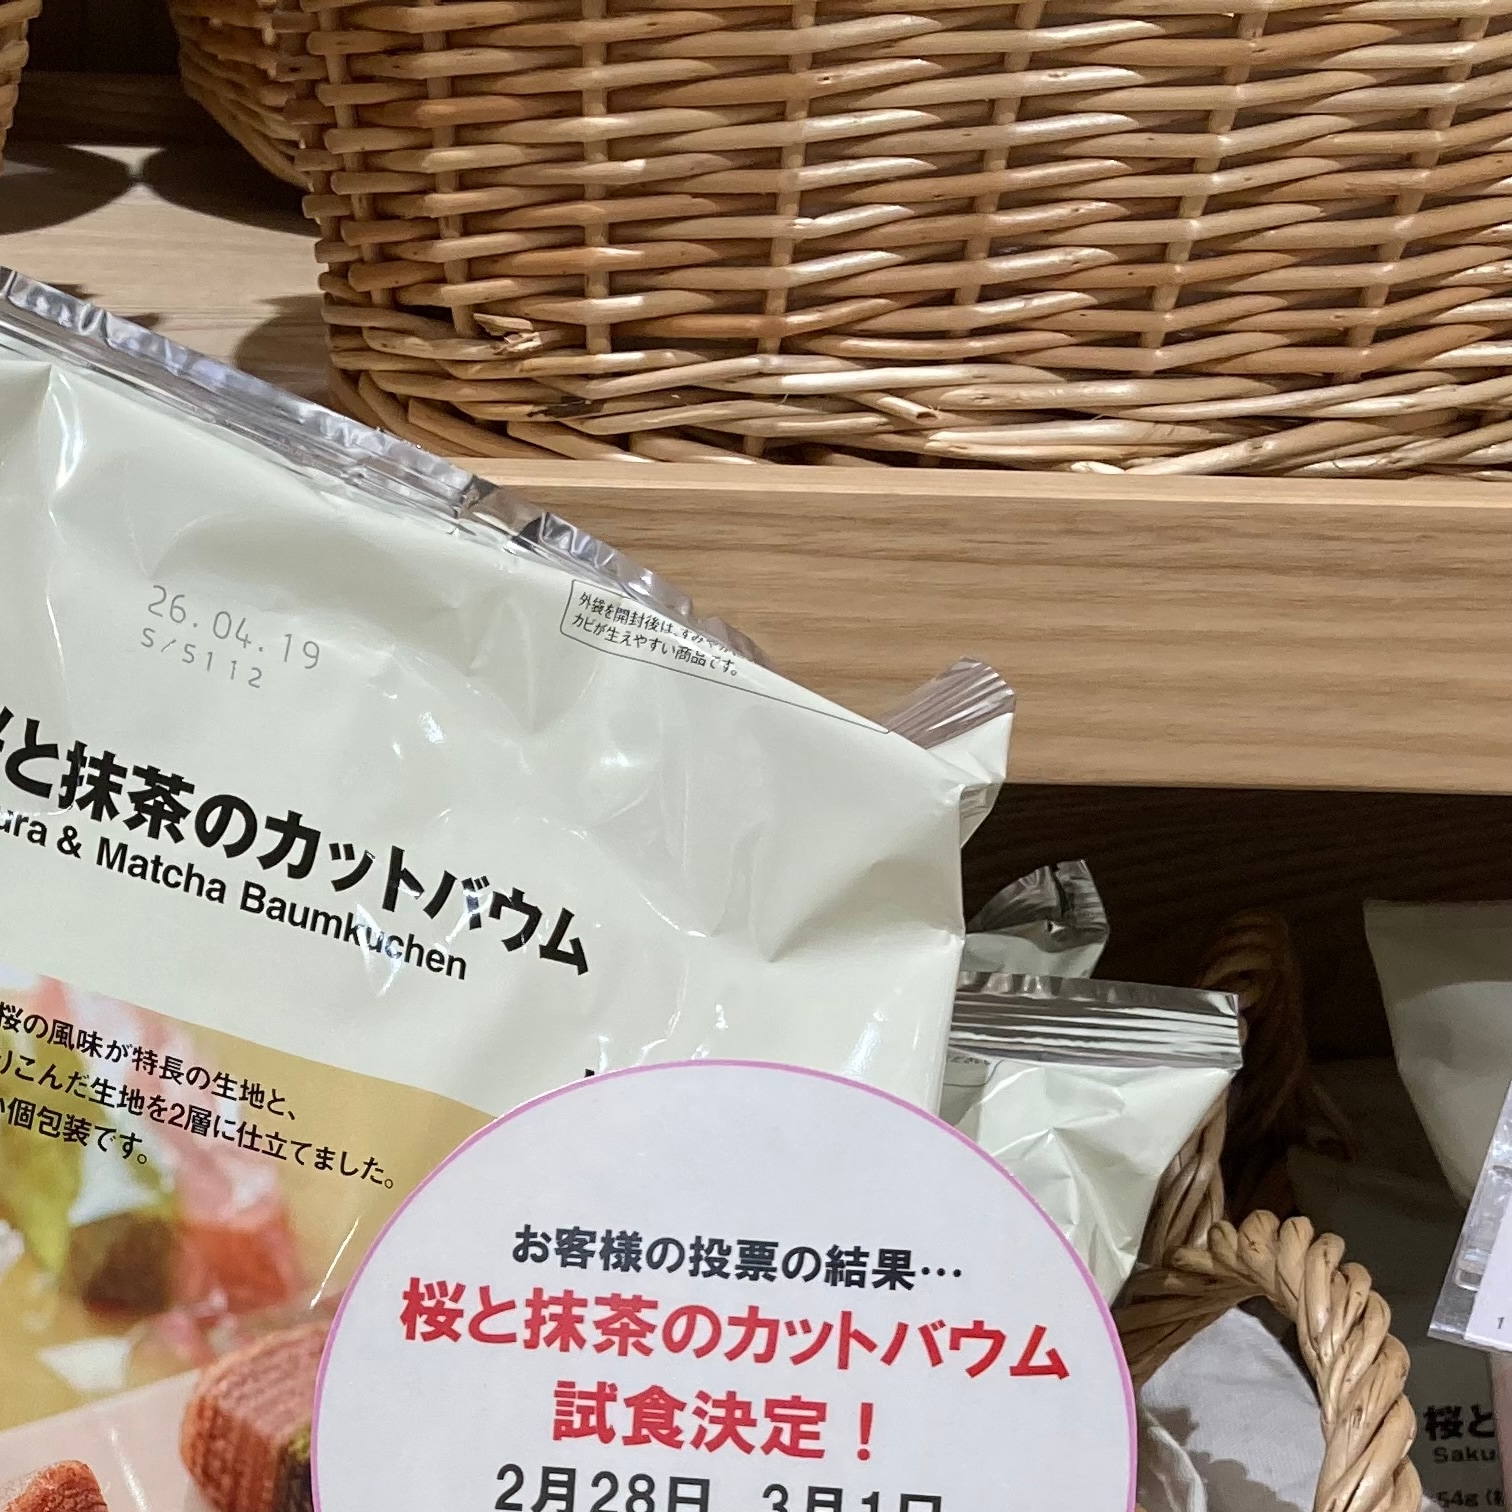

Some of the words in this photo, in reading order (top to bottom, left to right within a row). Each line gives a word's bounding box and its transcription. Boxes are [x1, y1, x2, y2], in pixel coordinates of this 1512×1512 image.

[147, 584, 320, 669] 26.04.19
[571, 613, 738, 677] カビが生えやすい商品です。
[56, 826, 83, 859] &
[95, 836, 227, 904] Matcha
[239, 881, 467, 981] Baumkuchen
[400, 1277, 1070, 1382] 桜と抹茶のカットバウム
[552, 1380, 874, 1461] 試食決定！
